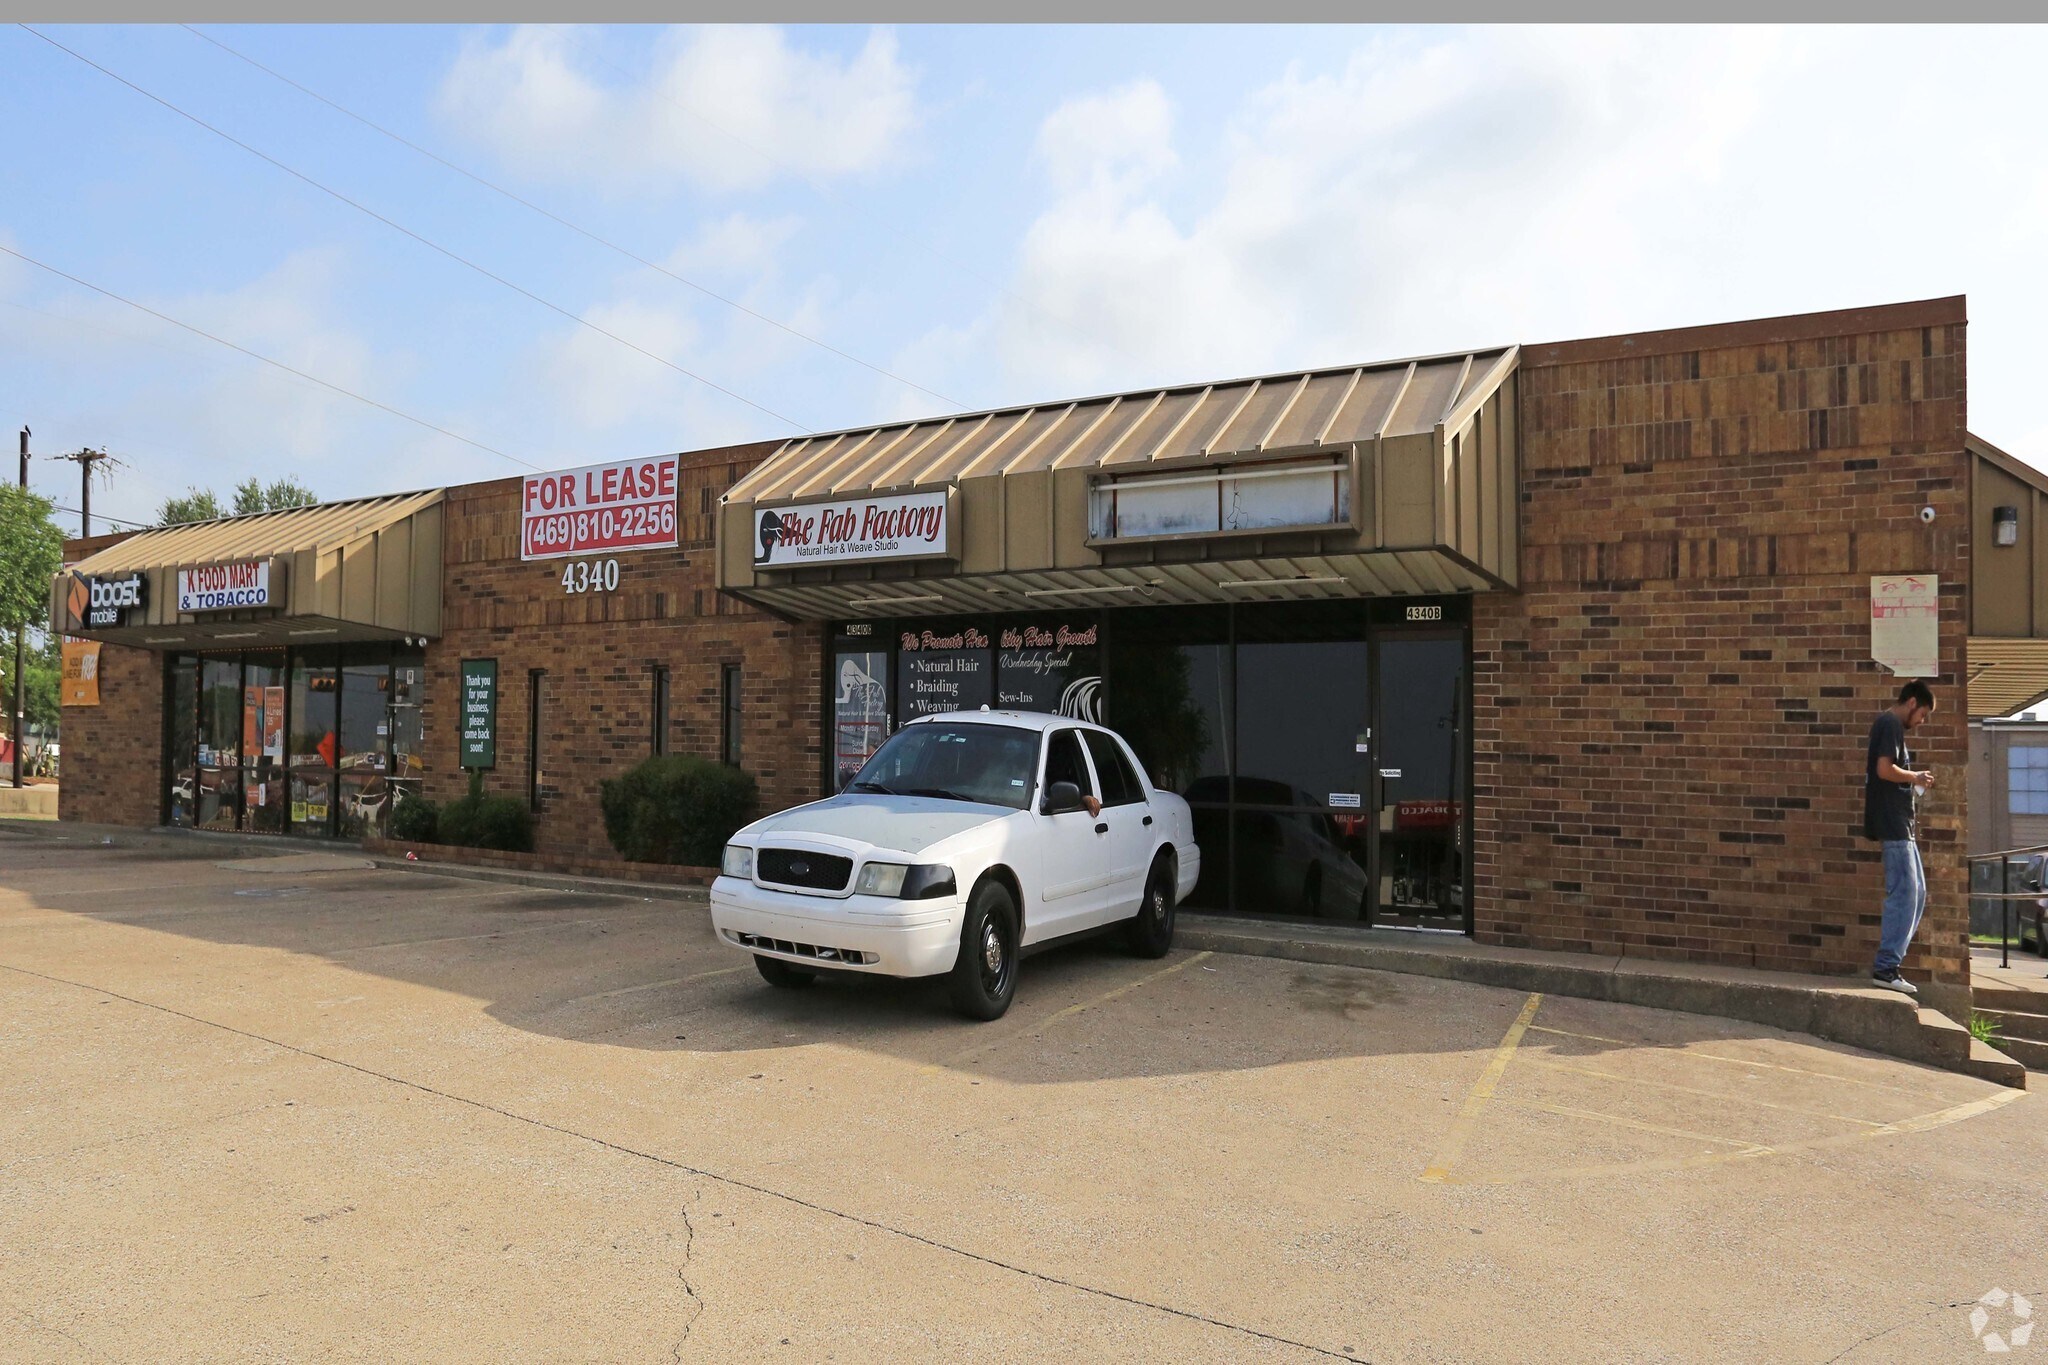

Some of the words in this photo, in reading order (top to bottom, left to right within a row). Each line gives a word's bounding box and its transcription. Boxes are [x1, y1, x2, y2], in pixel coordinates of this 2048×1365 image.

[525, 474, 577, 512] FOR
[586, 461, 675, 505] LEASE
[527, 503, 674, 555] (469)810-2256
[779, 512, 814, 547] The
[817, 506, 857, 544] Fab
[859, 504, 943, 542] Factory
[796, 545, 822, 557] Natural
[823, 544, 839, 555] Hair
[840, 543, 846, 553] &
[847, 542, 873, 553] Weave
[874, 539, 899, 551] Studio
[187, 569, 195, 593] K
[199, 565, 227, 592] FOOD
[229, 561, 260, 589] MART
[562, 559, 620, 594] 4340
[91, 574, 140, 607] boost
[181, 595, 191, 610] &
[197, 588, 266, 608] TOBACCO
[90, 609, 118, 625] mobile
[1407, 607, 1440, 619] 4340B
[902, 632, 919, 650] We
[921, 630, 964, 651] Promote
[1024, 626, 1053, 648] Hair
[1055, 624, 1097, 652] Growth
[917, 659, 954, 673] Natural
[956, 658, 979, 672] Hair
[1000, 652, 1043, 674] Wednesday
[1044, 651, 1073, 675] Special
[466, 674, 481, 686] Thank
[481, 677, 491, 688] you
[916, 679, 959, 696] Braiding
[468, 688, 476, 699] for
[476, 690, 488, 704] your
[999, 691, 1033, 703] Sew-Ins
[467, 701, 489, 714] business,
[916, 699, 959, 712] Weaving
[469, 714, 485, 728] please
[464, 730, 477, 739] come
[477, 728, 490, 739] back
[469, 741, 484, 752] soon!
